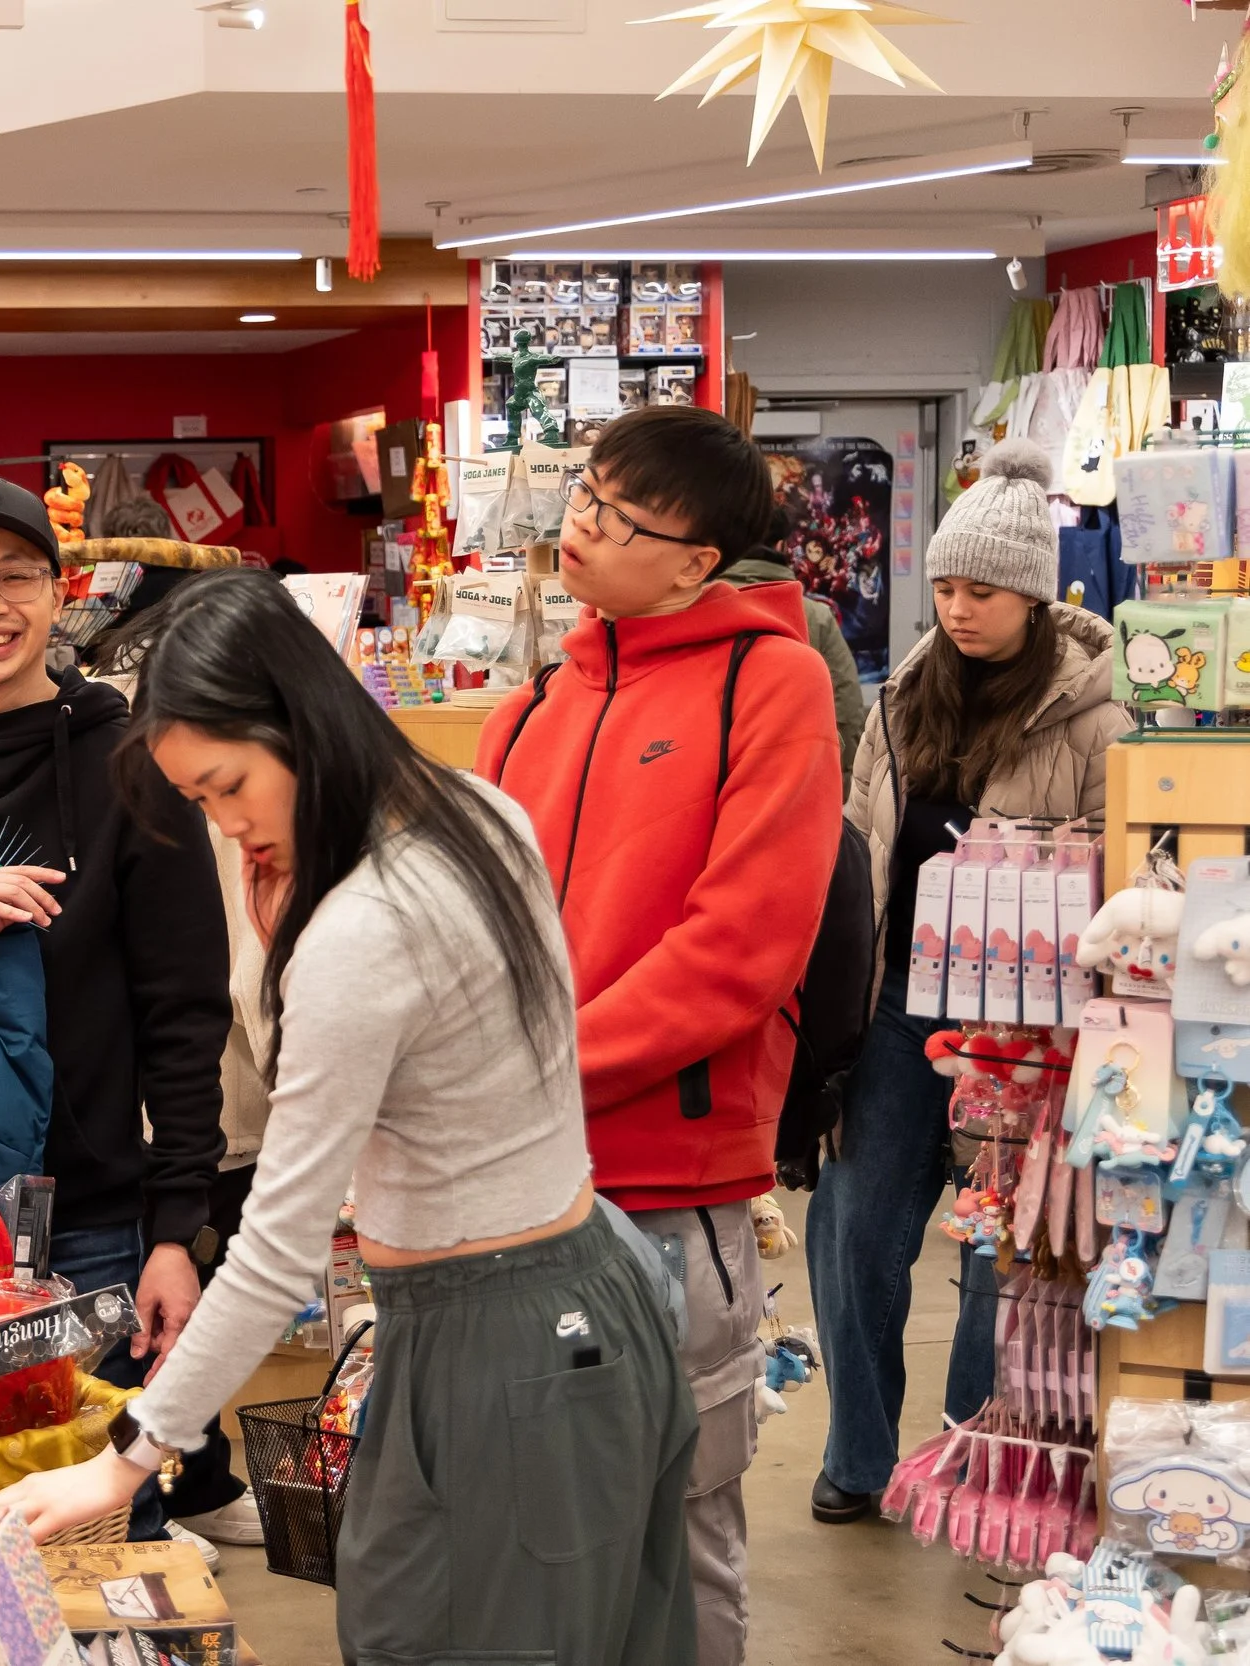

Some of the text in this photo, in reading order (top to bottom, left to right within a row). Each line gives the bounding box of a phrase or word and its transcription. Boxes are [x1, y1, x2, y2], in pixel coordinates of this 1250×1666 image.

[1168, 199, 1216, 285] EX
[463, 467, 506, 481] YOGA JANES
[529, 463, 560, 474] YOGA
[455, 589, 480, 602] YOGA
[488, 594, 512, 607] JOES
[544, 595, 573, 605] YOGA
